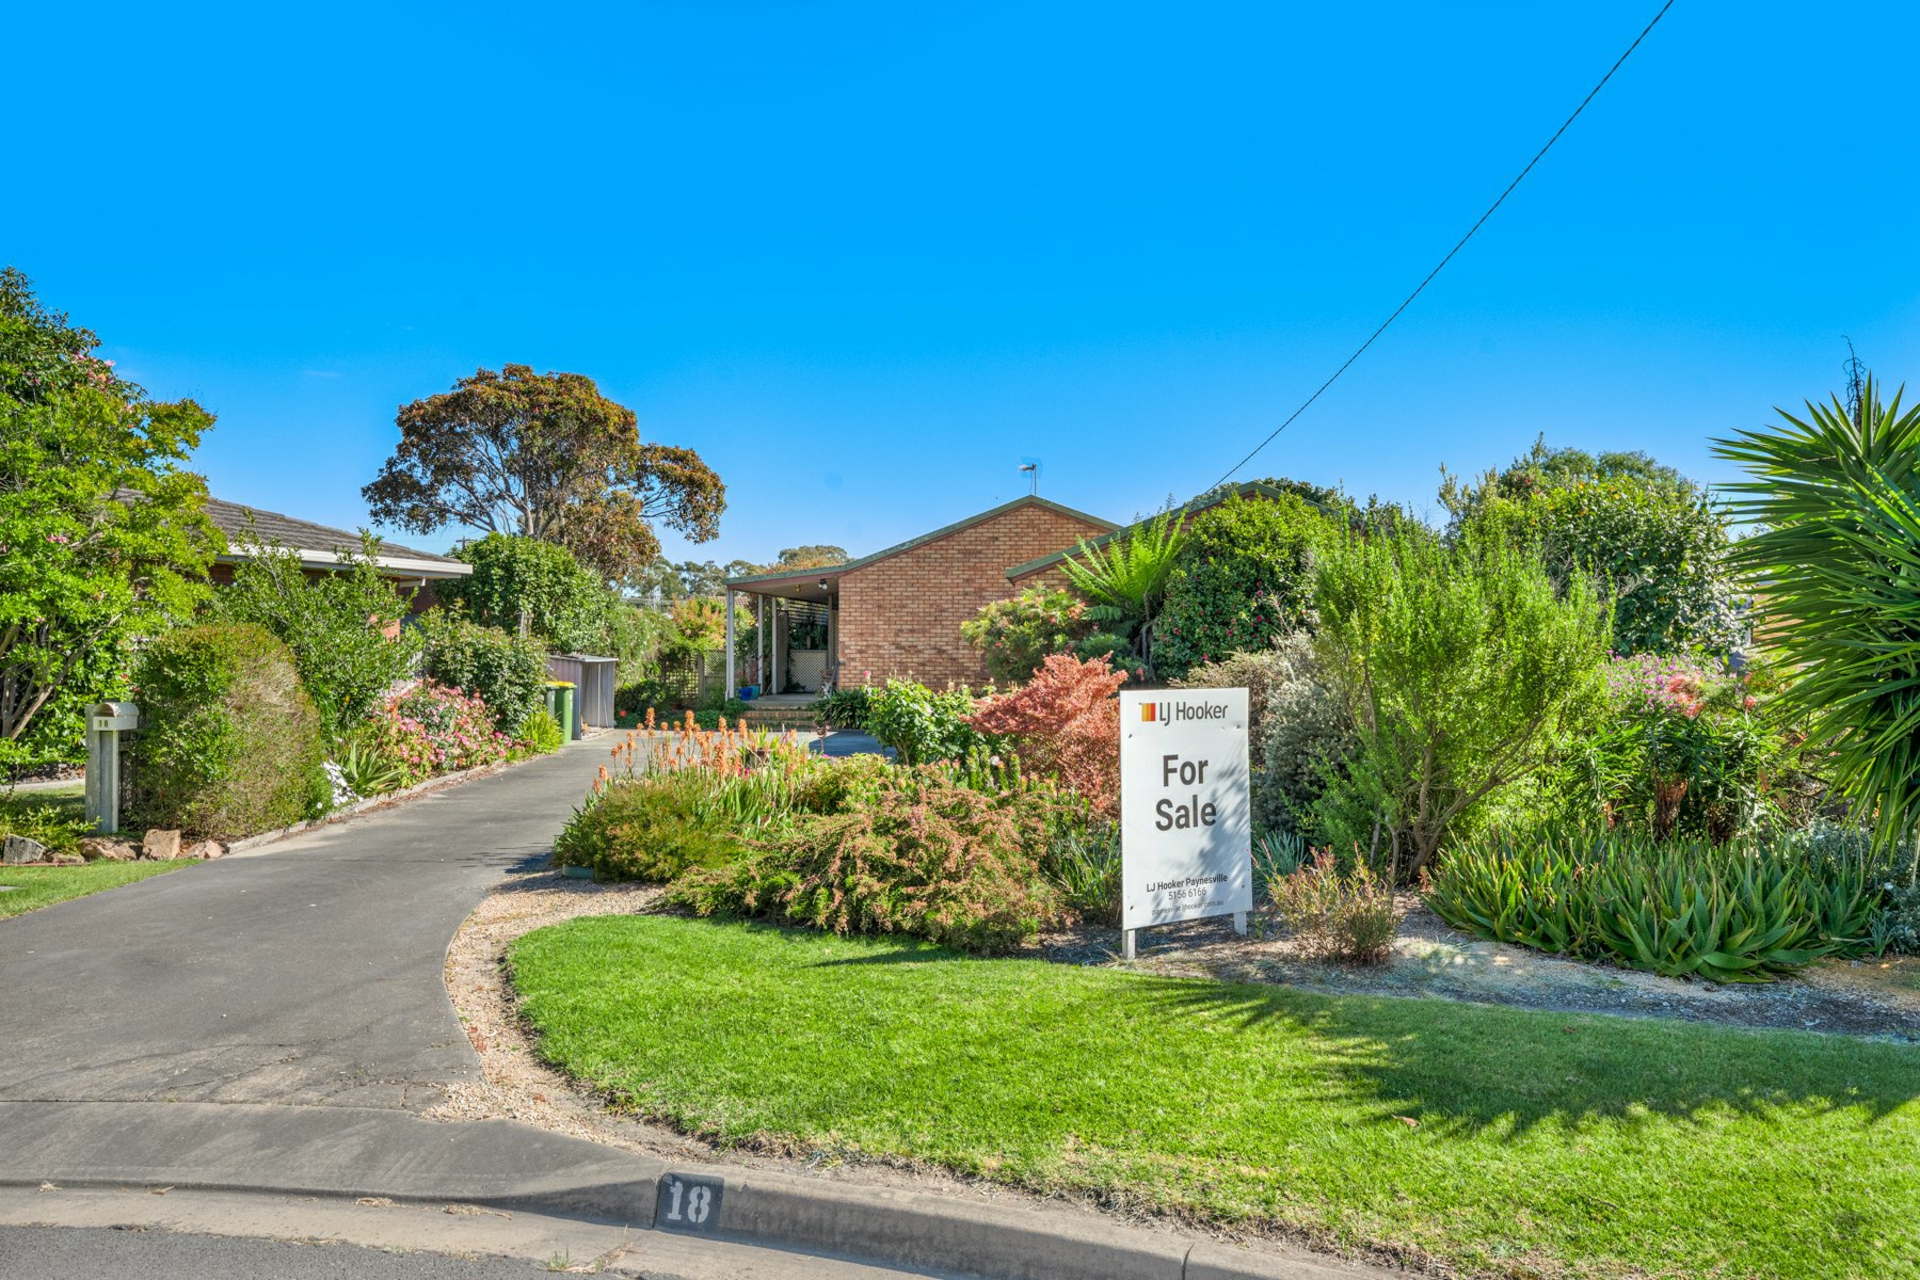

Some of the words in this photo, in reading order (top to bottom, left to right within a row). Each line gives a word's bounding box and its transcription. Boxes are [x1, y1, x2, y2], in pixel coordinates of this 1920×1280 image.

[98, 719, 109, 728] 18
[1159, 702, 1171, 726] LJ
[1175, 701, 1228, 721] Hooker
[1163, 754, 1209, 788] For
[1155, 794, 1217, 832] Sale
[1146, 882, 1156, 893] LJ
[1157, 879, 1185, 891] Hooker
[1185, 873, 1229, 888] Paynesville
[1168, 889, 1187, 901] 5156
[1187, 886, 1207, 898] 6166
[1151, 900, 1225, 916] paynesve.ljhooker.com.au
[667, 1181, 711, 1223] 18
